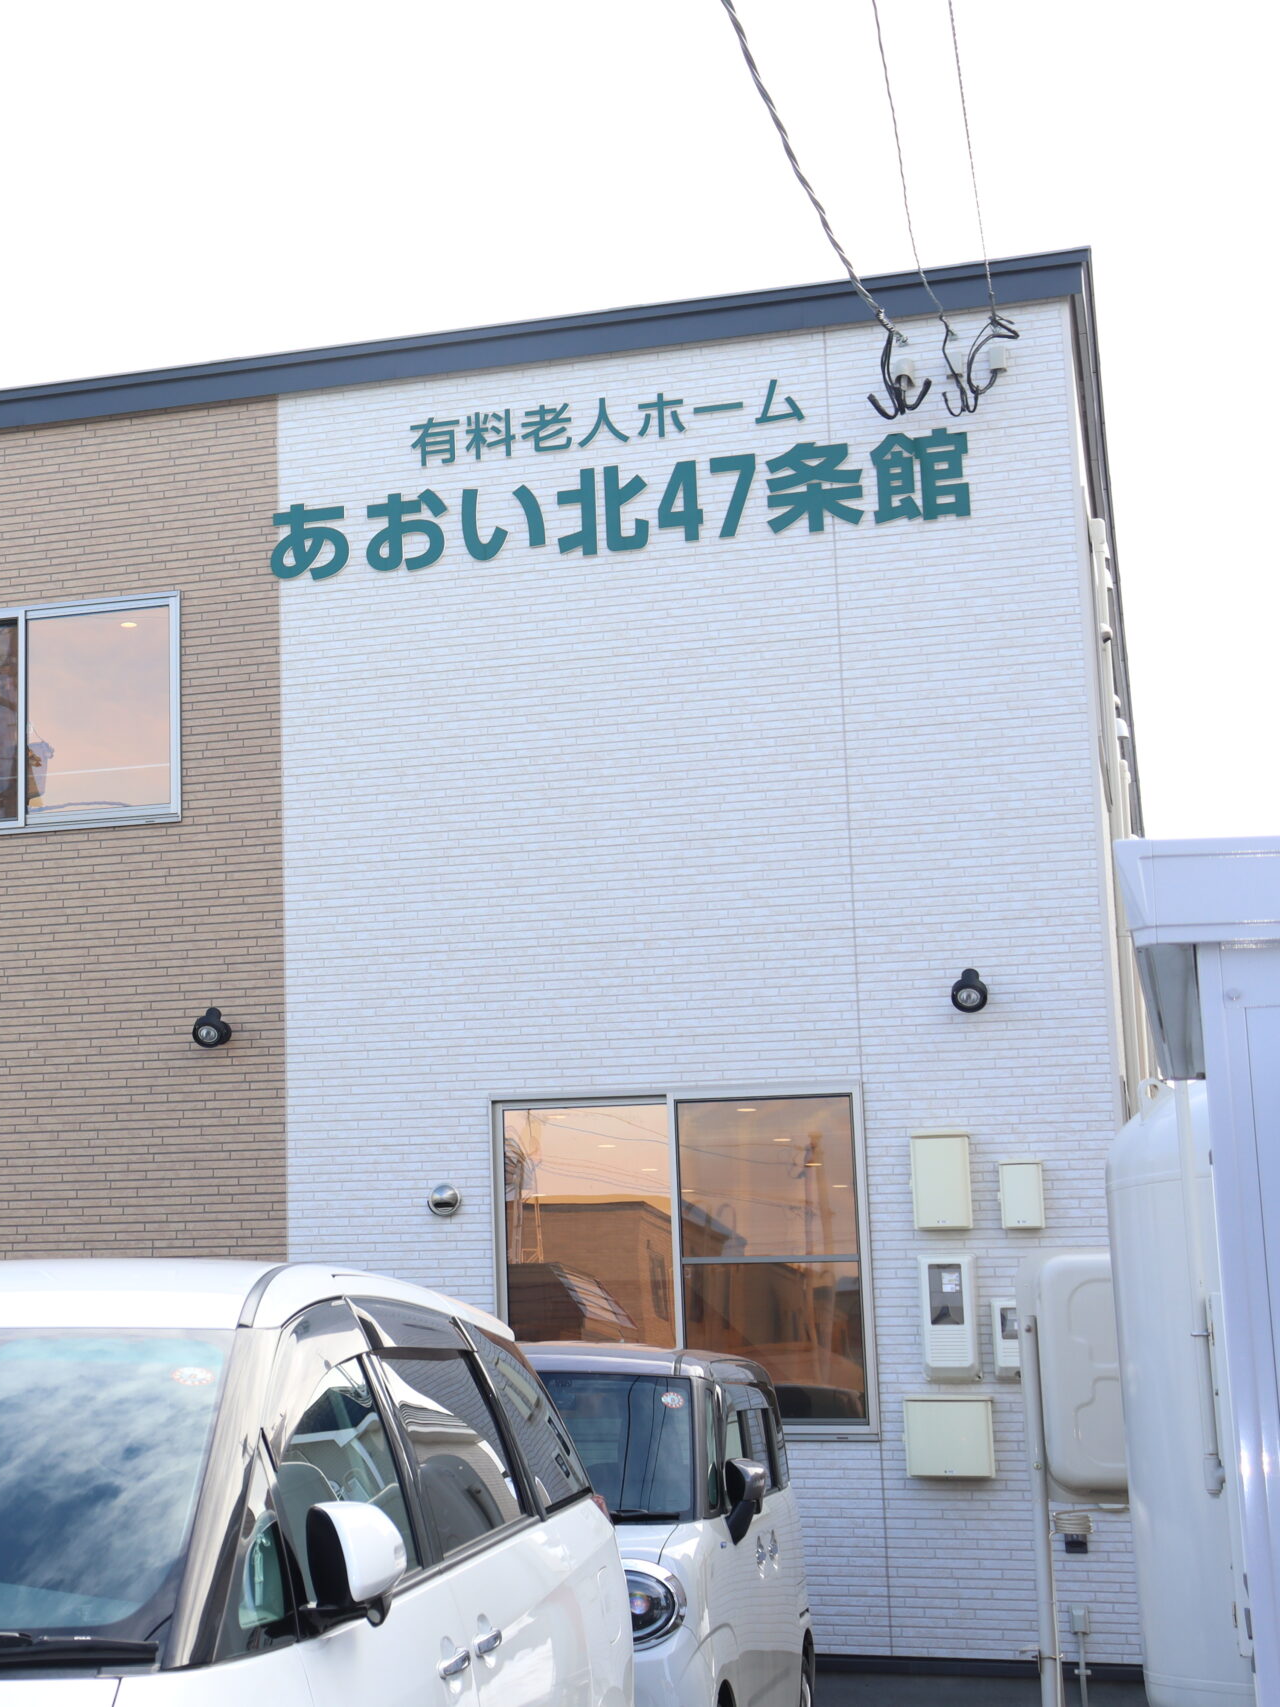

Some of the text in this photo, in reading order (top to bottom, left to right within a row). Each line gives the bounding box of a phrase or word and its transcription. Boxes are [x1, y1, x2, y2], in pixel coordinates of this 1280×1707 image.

[409, 378, 806, 467] 有料老人ホーム
[269, 427, 971, 581] あおい北47条館
